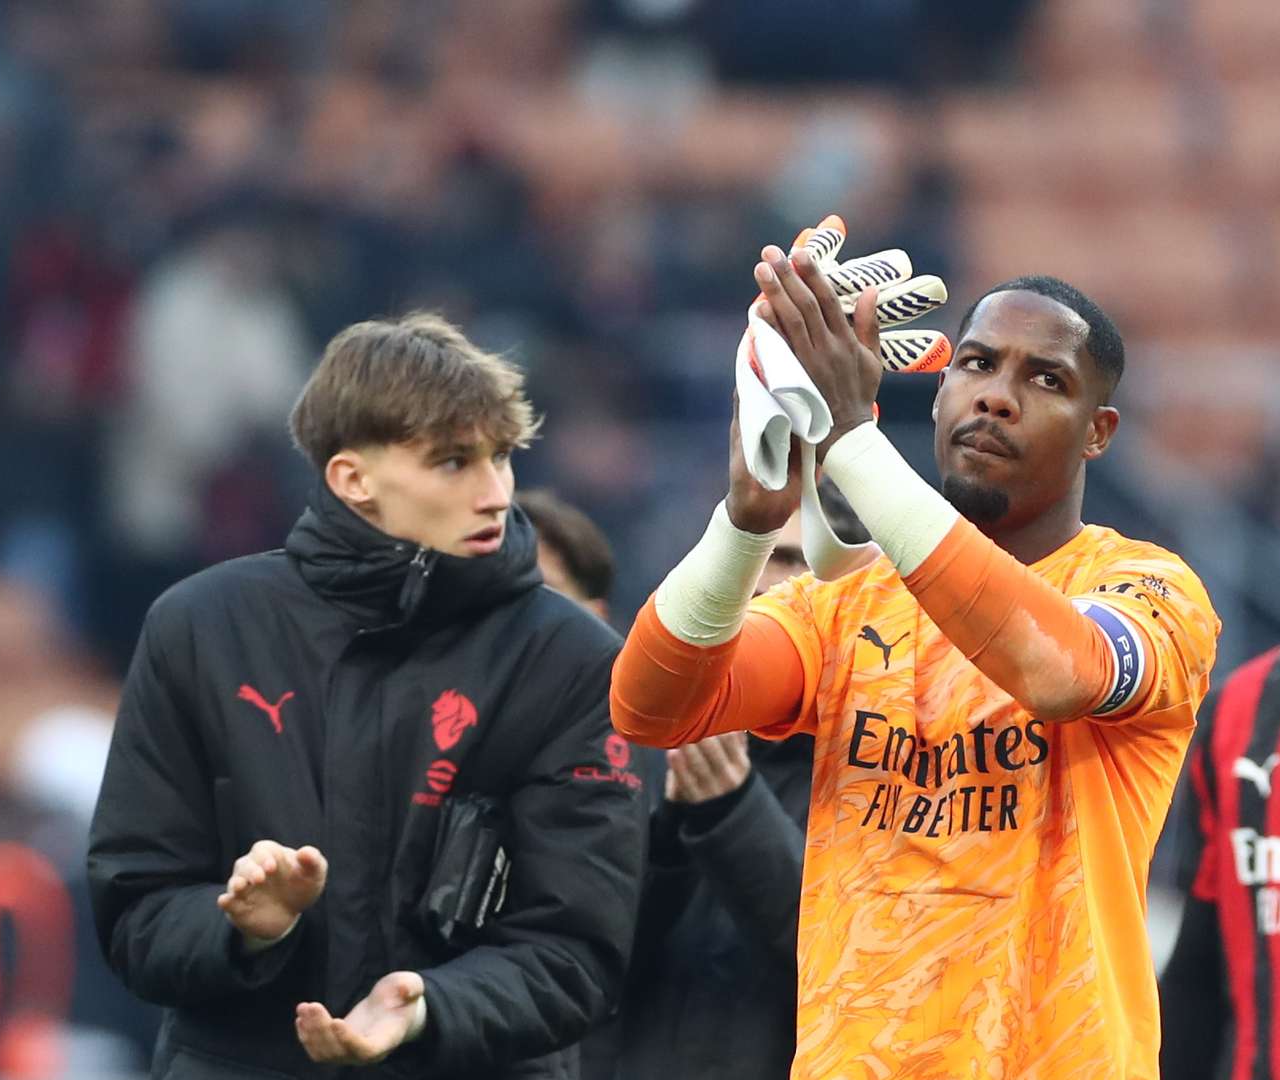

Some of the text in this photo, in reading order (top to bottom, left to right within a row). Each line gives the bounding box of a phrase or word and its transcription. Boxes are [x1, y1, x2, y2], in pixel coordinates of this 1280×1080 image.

[848, 709, 1049, 788] Emirates
[860, 784, 1018, 838] FLY BETTER
